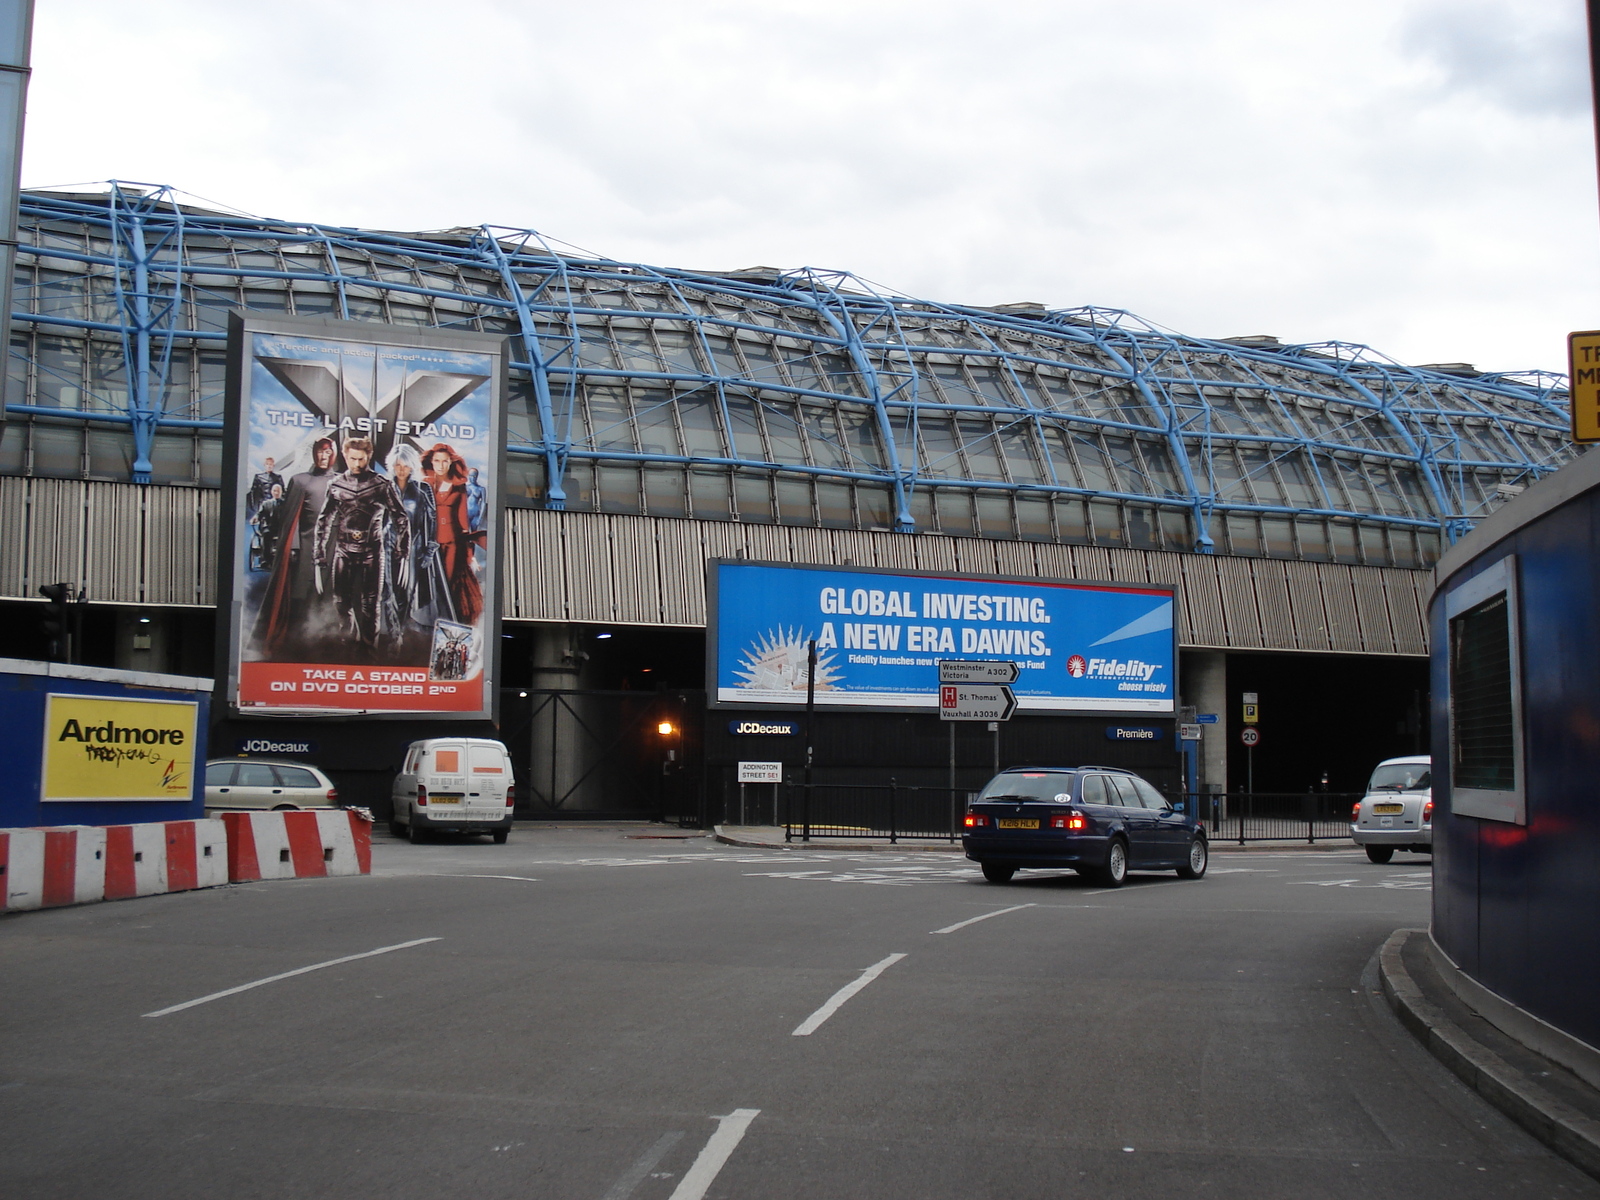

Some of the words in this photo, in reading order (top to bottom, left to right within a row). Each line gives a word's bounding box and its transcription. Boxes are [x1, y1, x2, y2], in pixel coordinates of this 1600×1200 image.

[320, 347, 340, 355] and
[344, 349, 375, 358] action
[268, 410, 315, 427] THE
[324, 414, 388, 432] LAST
[395, 420, 475, 439] STAND
[819, 587, 917, 618] GLOBAL
[922, 592, 1051, 624] INVESTING.
[819, 622, 837, 649] A
[843, 623, 901, 651] NEW
[907, 626, 956, 653] ERA
[961, 627, 1052, 657] DAWNS.
[848, 654, 879, 666] Fidelity
[879, 655, 915, 666] launches
[916, 658, 933, 666] new
[1026, 660, 1045, 670] Fund
[303, 669, 347, 680] TAKE
[352, 671, 365, 681] A
[369, 671, 426, 682] STAND
[1087, 658, 1156, 682] Fidelity
[270, 682, 296, 692] ON
[302, 682, 339, 693] DVD
[344, 684, 424, 695] OCTOBER
[428, 685, 457, 695] 2ND
[1118, 682, 1143, 691] choose
[1144, 682, 1167, 693] wisely
[945, 688, 954, 700] H
[942, 710, 972, 718] Vauxhall
[1247, 706, 1254, 715] P
[58, 718, 185, 746] Ardmore
[736, 722, 792, 734] JCDecaux
[1116, 728, 1154, 739] Première
[1243, 732, 1257, 741] 20
[242, 740, 309, 752] JCDecaux
